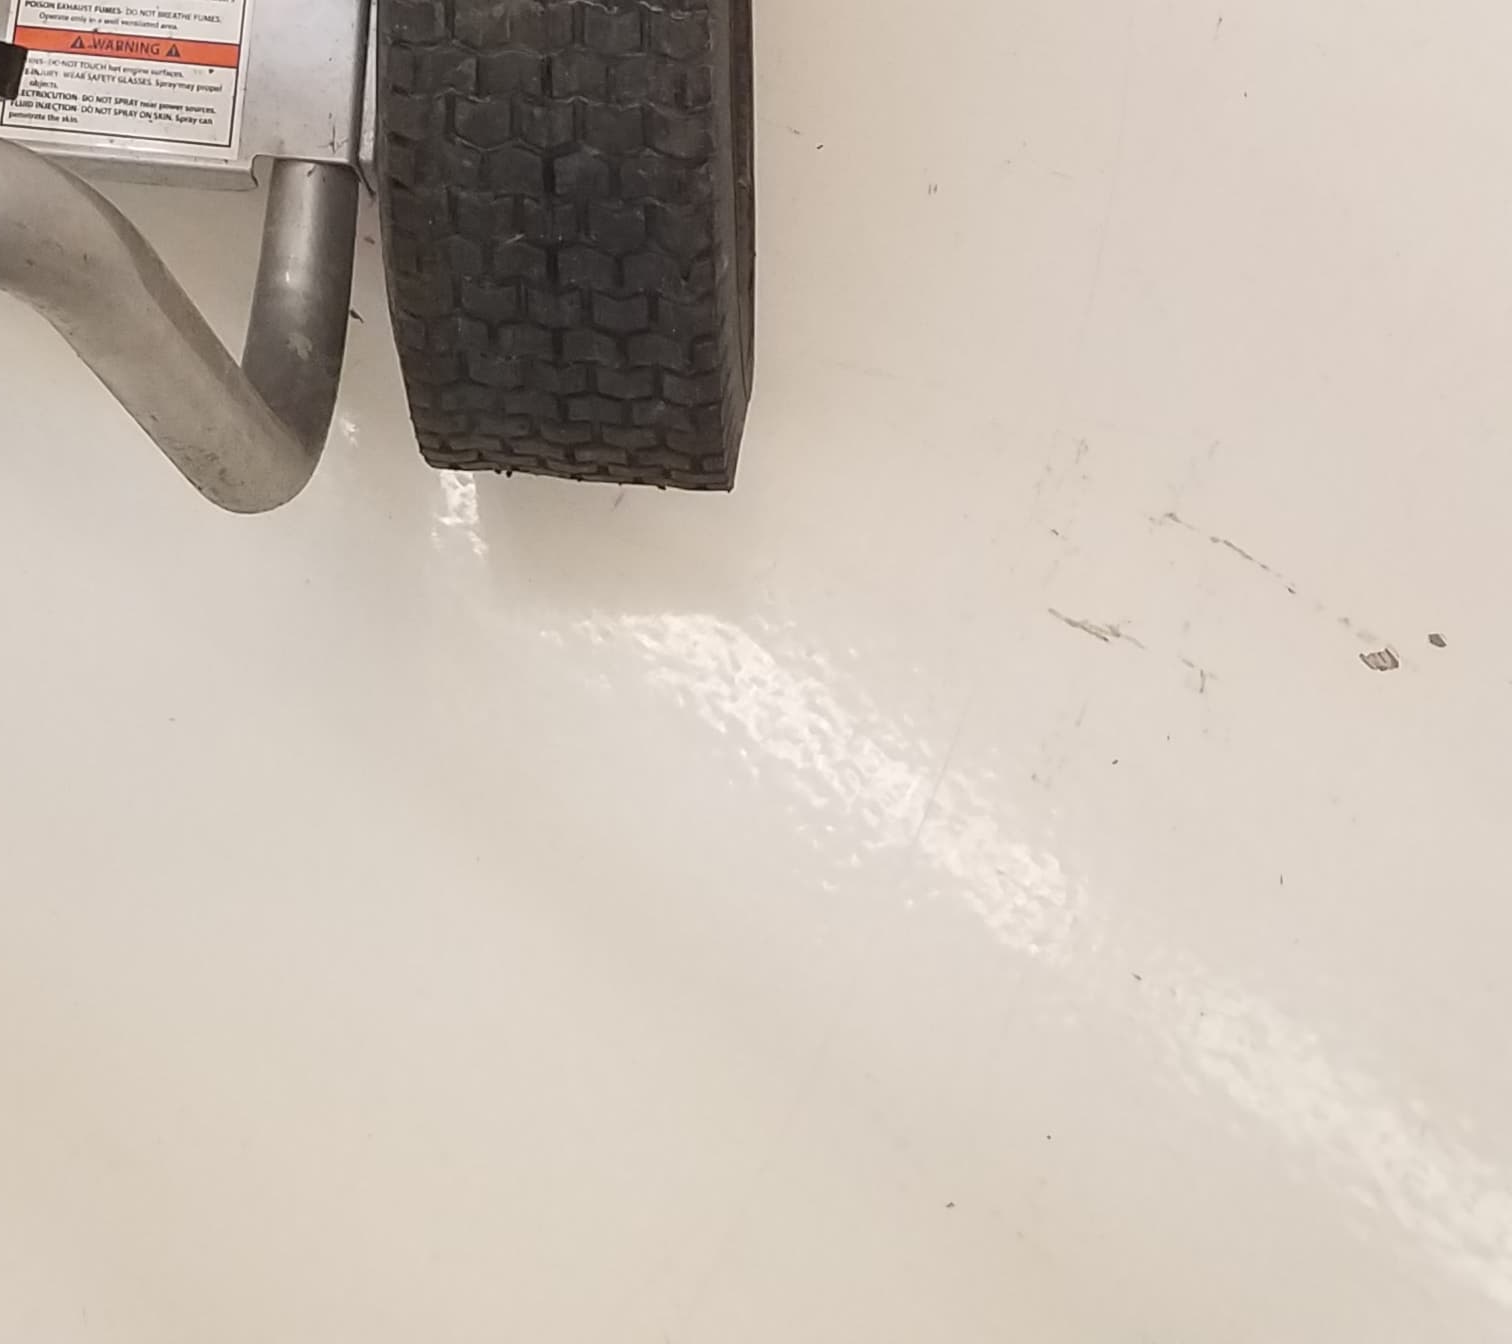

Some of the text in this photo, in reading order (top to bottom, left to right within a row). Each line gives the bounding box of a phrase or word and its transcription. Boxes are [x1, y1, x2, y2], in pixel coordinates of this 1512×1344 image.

[25, 0, 55, 9] POISON
[126, 7, 138, 16] DO
[139, 9, 156, 17] NOT
[92, 37, 161, 56] WARNING
[80, 61, 107, 70] TOUCH
[87, 73, 116, 83] SAFETY
[81, 94, 94, 103] DO
[96, 96, 112, 105] NOT
[114, 97, 138, 106] SPRAY
[81, 105, 94, 114] DO
[95, 107, 112, 116] NOT
[113, 108, 138, 117] SPRAY
